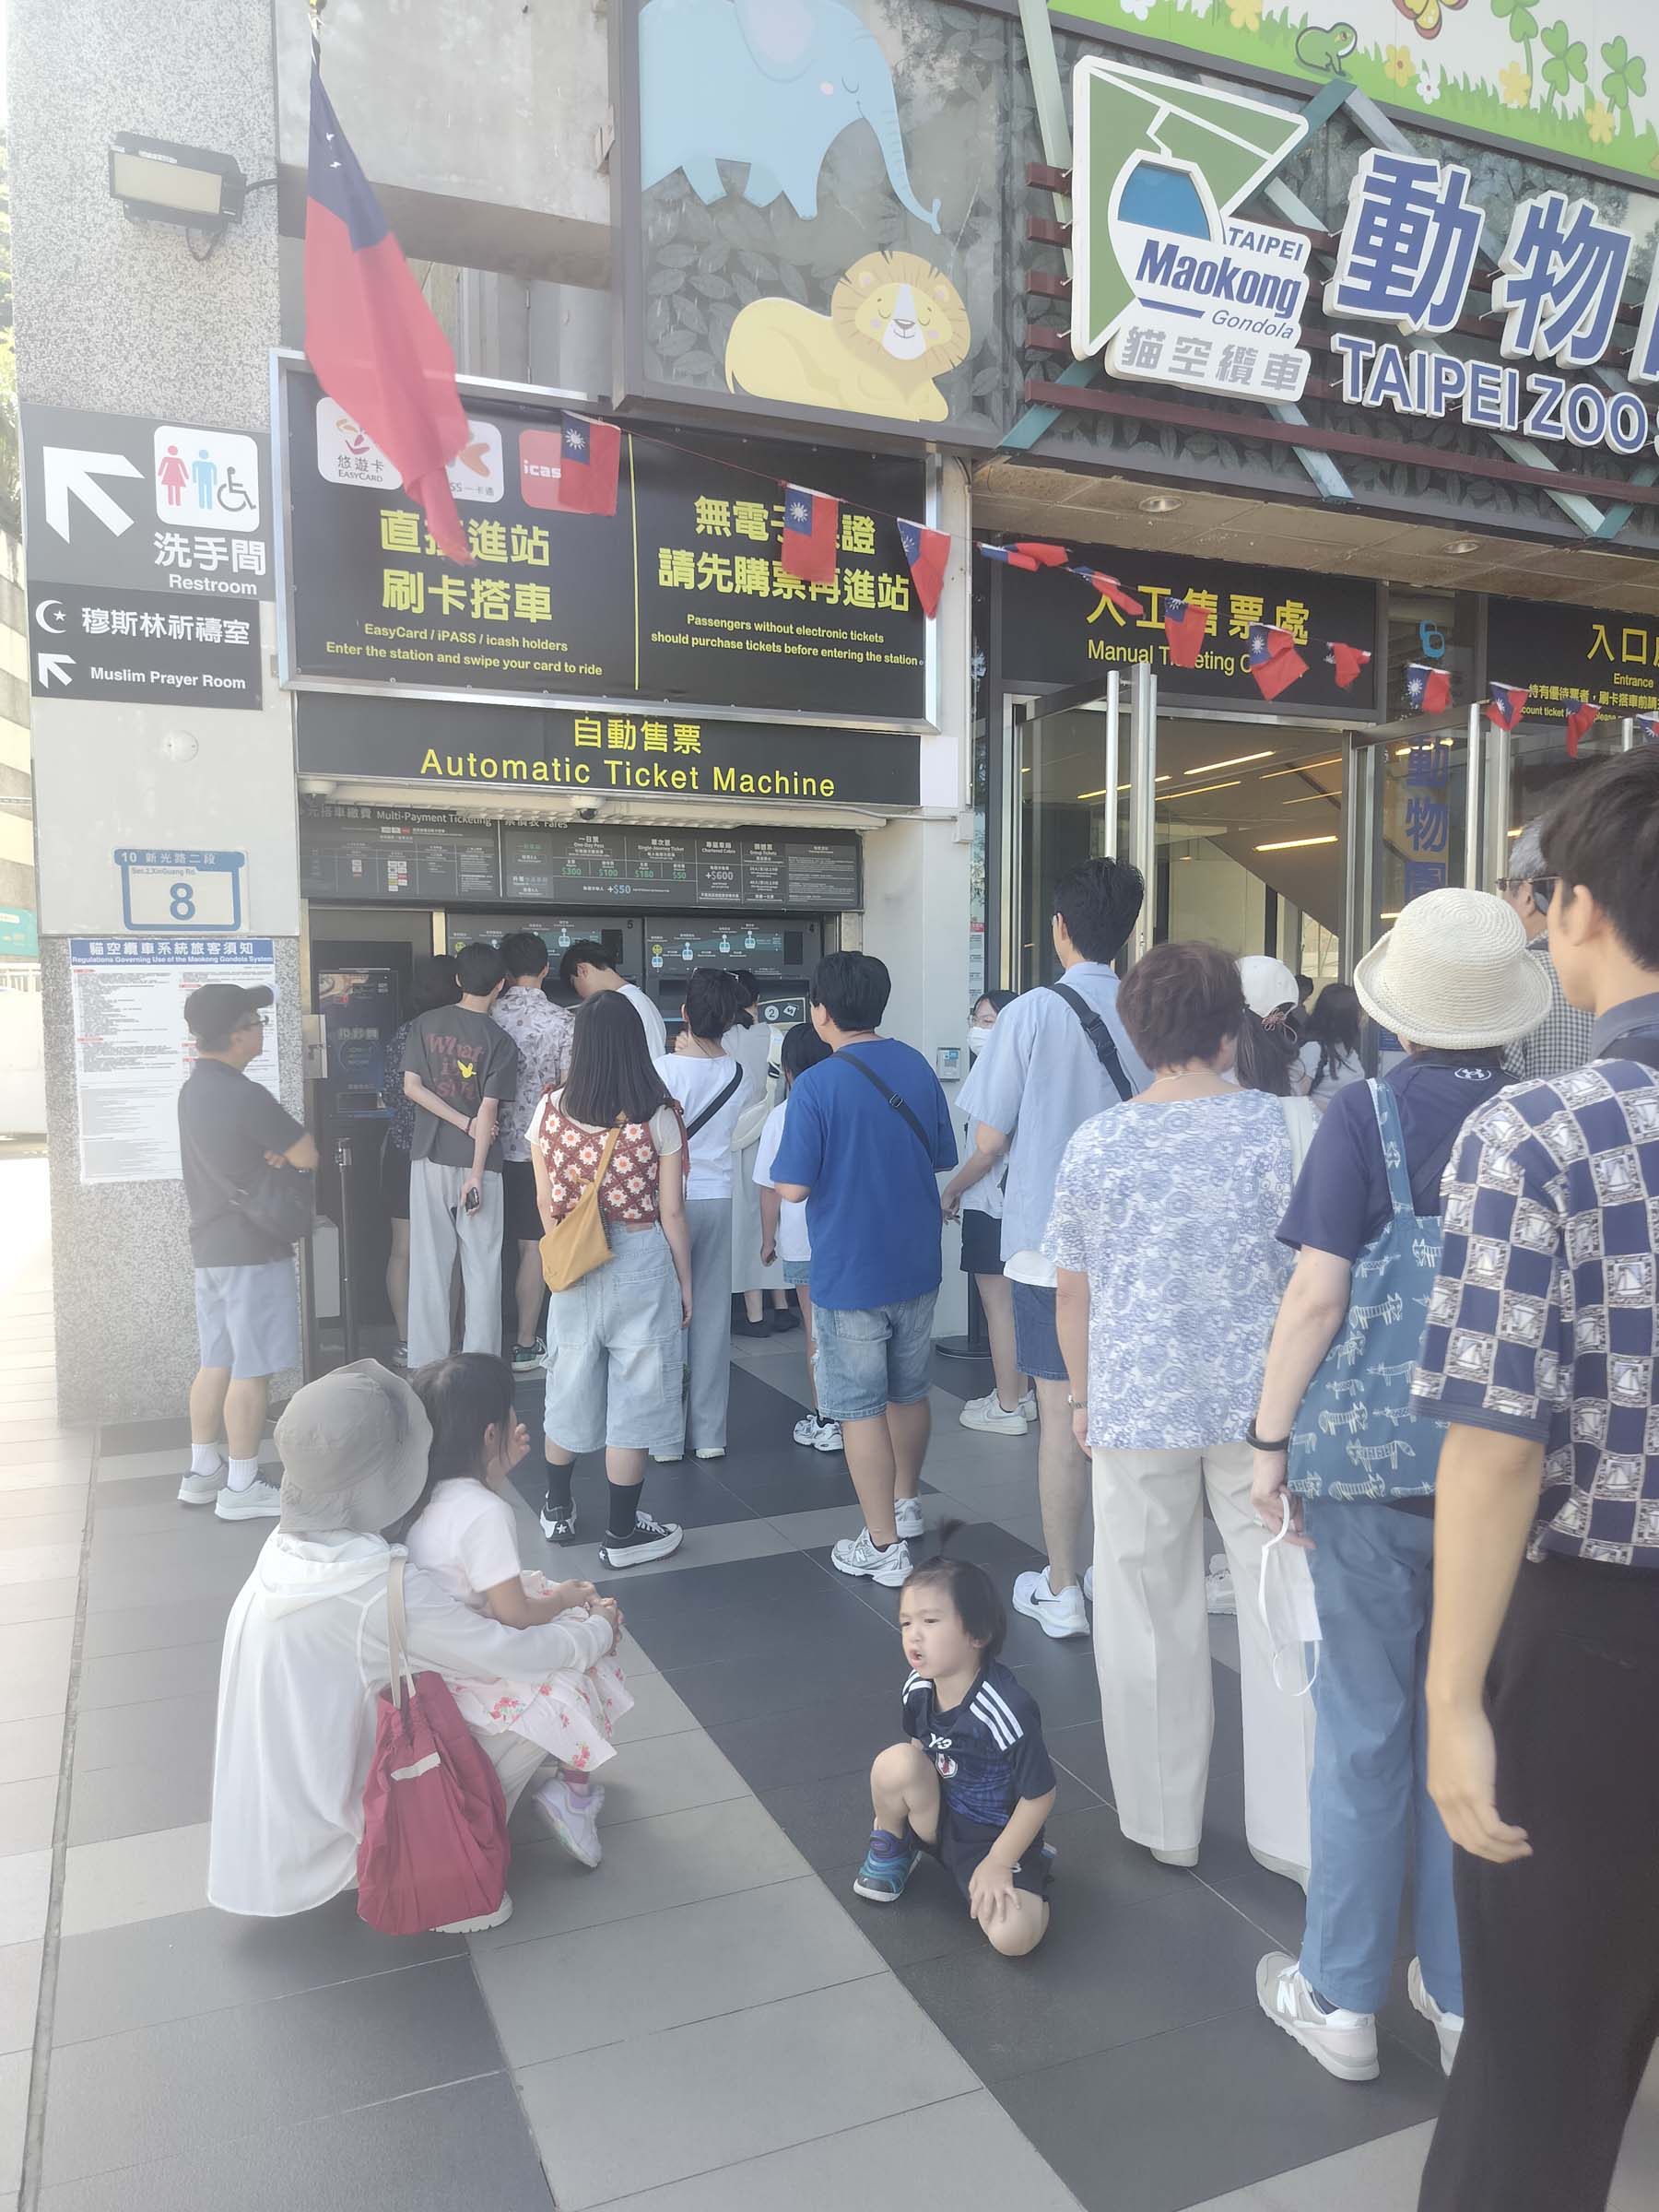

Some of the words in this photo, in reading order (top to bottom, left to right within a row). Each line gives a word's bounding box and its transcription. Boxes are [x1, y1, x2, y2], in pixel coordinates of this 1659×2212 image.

[1228, 227, 1304, 262] TAIPEI
[1135, 238, 1301, 317] Maokong
[1333, 150, 1659, 380] 動物
[1211, 309, 1294, 341] Gondola
[1120, 325, 1304, 393] 貓空纜車
[1333, 335, 1520, 431] TAIPEI
[1525, 374, 1649, 454] ZOO
[337, 454, 384, 473] 悠遊卡
[524, 460, 561, 479] icas
[694, 496, 876, 555] 無電證
[153, 531, 267, 576] 洗手間
[168, 573, 258, 595] Restroom
[382, 569, 553, 623] 刷卡搭車
[81, 607, 251, 646] 穆斯林祈禱室
[364, 623, 428, 641] EasyCard
[437, 629, 477, 644] iPASS
[486, 634, 520, 649] icash
[522, 636, 569, 653] holders
[687, 614, 752, 632] Passengers
[753, 620, 794, 636] without
[795, 625, 848, 641] electronic
[850, 629, 885, 644] tickets
[326, 641, 363, 656] Enter
[365, 643, 387, 658] the
[389, 646, 434, 663] station
[436, 650, 461, 665] and
[464, 653, 500, 670] swipe
[502, 657, 531, 671] your
[533, 656, 562, 672] card
[564, 661, 577, 674] to
[579, 663, 603, 677] ride
[651, 631, 689, 645] should
[691, 635, 744, 651] purchase
[745, 640, 782, 654] tickets
[783, 643, 819, 657] before
[820, 647, 865, 664] entering
[865, 650, 883, 663] the
[1088, 639, 1154, 665] Manual
[90, 666, 146, 683] Muslim
[150, 671, 199, 688] Prayer
[202, 675, 247, 689] Room
[1613, 673, 1654, 688] Entrance
[574, 716, 702, 755] 自動售票
[420, 748, 592, 784] Automatic
[603, 759, 700, 791] Ticket
[712, 766, 836, 798] Machine
[376, 810, 447, 823] Multi-Payment
[121, 852, 137, 864] 10
[145, 853, 217, 865] 新光路二段
[598, 868, 618, 877] $100
[607, 883, 632, 895] +$50
[705, 870, 734, 880] +$600
[170, 882, 196, 921] 8
[72, 956, 114, 964] Regulations
[115, 956, 151, 964] Governing
[152, 956, 166, 964] Use
[167, 956, 174, 964] of
[175, 956, 187, 964] the
[187, 956, 219, 964] Maokong
[219, 956, 248, 964] Gondola
[249, 956, 274, 964] System
[89, 942, 254, 956] 貓空纜車系統旅客須知
[769, 1007, 776, 1018] 2
[928, 1732, 953, 1750] Y-3
